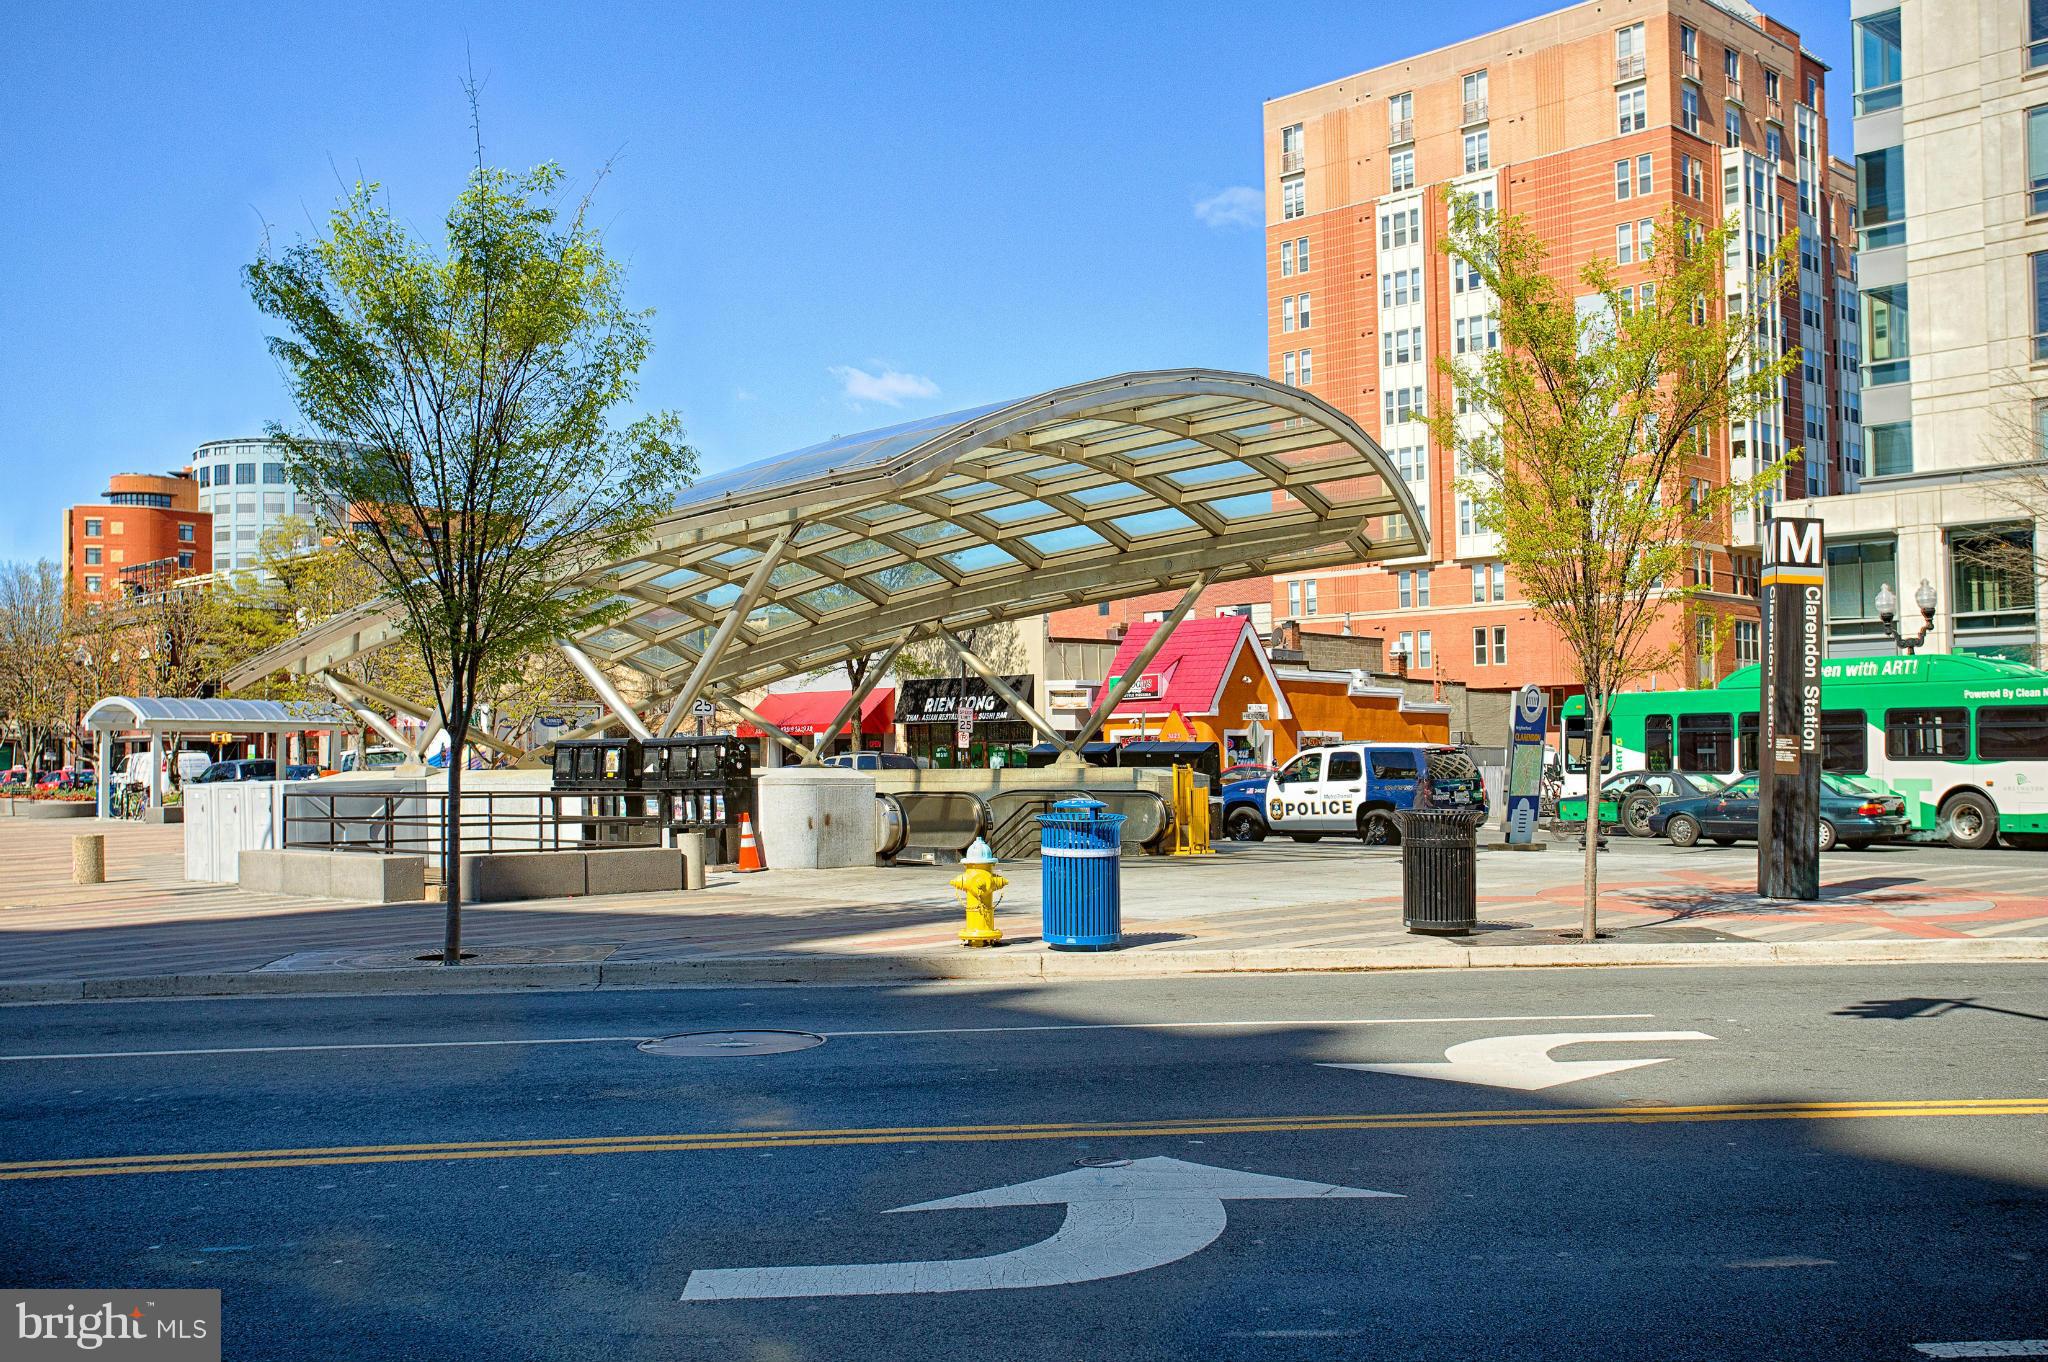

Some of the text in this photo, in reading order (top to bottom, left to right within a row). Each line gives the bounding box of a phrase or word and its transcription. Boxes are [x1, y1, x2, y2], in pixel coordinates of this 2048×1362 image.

[1762, 522, 1776, 565] M
[1780, 521, 1820, 563] M
[1803, 586, 1821, 750] Clarendon Station
[1846, 661, 1878, 677] with
[1881, 659, 1918, 676] ART!
[1964, 689, 2000, 699] Powered
[2002, 688, 2014, 699] By
[2015, 687, 2041, 697] Clean
[694, 699, 712, 712] 25
[923, 696, 956, 712] RIEN
[978, 712, 996, 720] SUSHI
[996, 711, 1008, 719] BAR
[960, 720, 972, 730] 25
[1515, 732, 1541, 742] CLARENDON
[1285, 800, 1353, 816] POLICE
